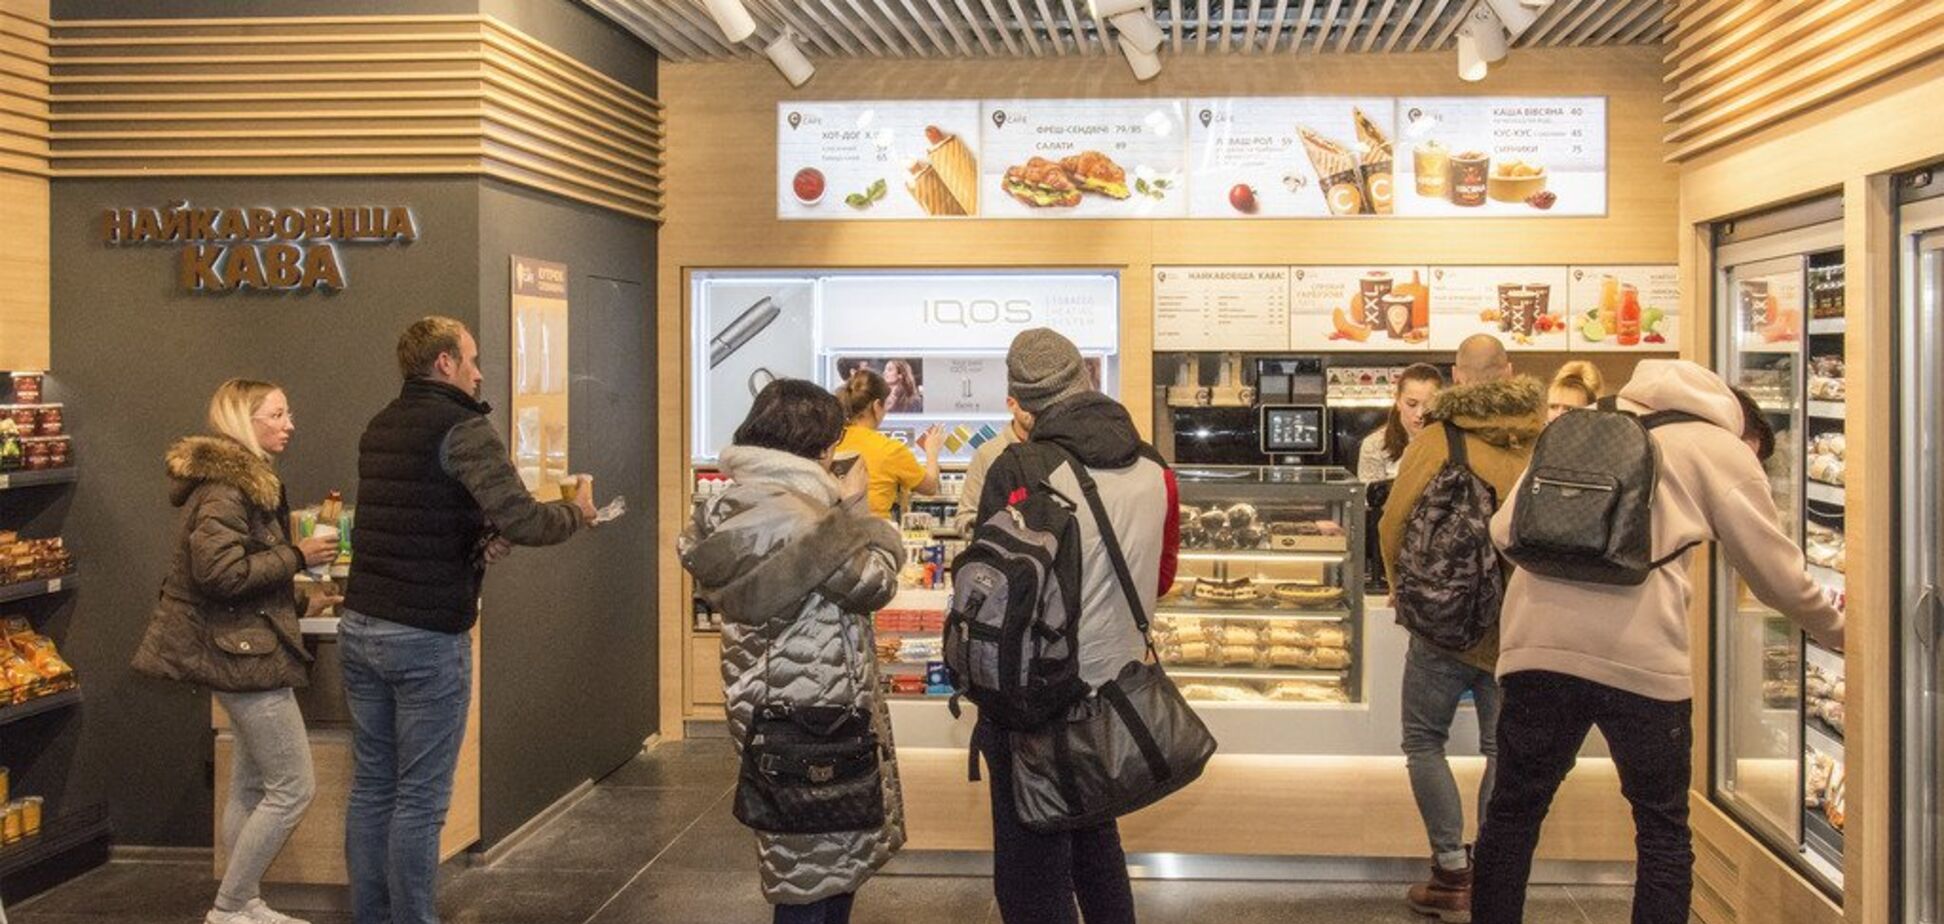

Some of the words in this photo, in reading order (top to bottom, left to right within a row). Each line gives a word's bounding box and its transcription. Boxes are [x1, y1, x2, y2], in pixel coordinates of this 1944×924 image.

[1216, 137, 1273, 145] ЛВАШ-РОЛ
[102, 200, 417, 243] НАЙКАВОВІША
[181, 242, 346, 292] КАВА
[923, 299, 1032, 328] IQOS
